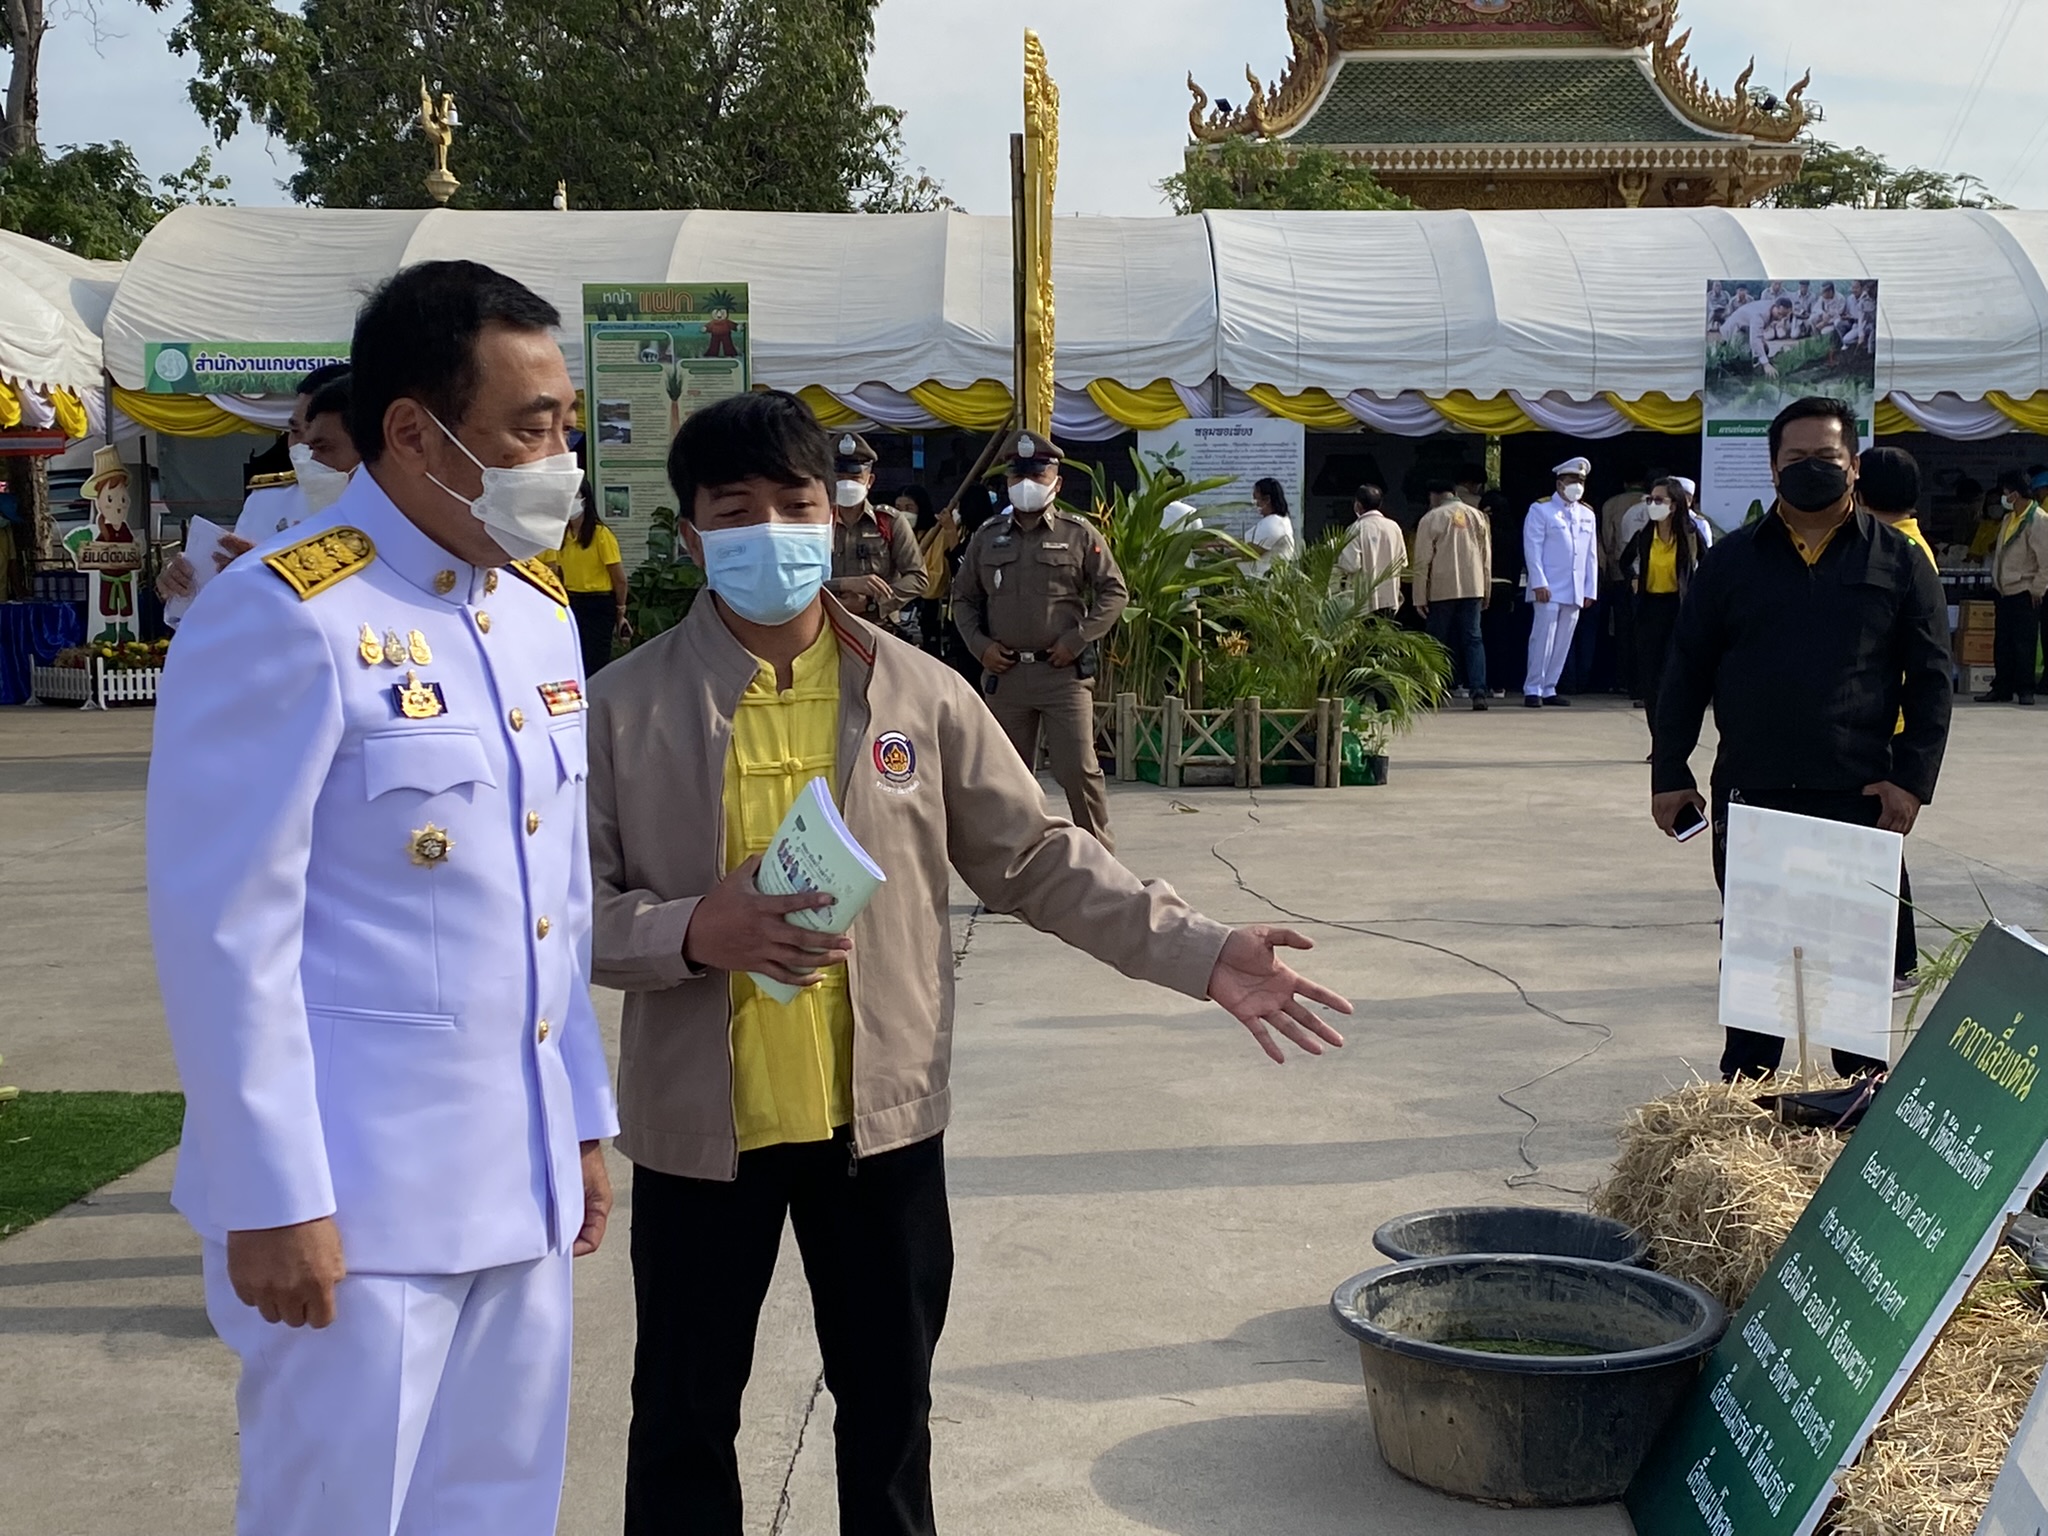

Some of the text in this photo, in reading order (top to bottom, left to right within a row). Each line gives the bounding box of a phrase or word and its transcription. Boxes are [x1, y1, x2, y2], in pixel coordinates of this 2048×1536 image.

[603, 287, 694, 313] หญ้า แฝก
[1948, 1011, 2041, 1102] คาถาเลี้ยงดิน
[1895, 1077, 1995, 1191] เลี้ยงดิน ให้ดินเลี้ยงพืช
[1860, 1150, 1948, 1253] feed the soil and let
[1819, 1206, 1909, 1322] the soil feed the plant
[1710, 1363, 1796, 1518] เลี้ยงแม่ธรณี ให้แม่ธรณี
